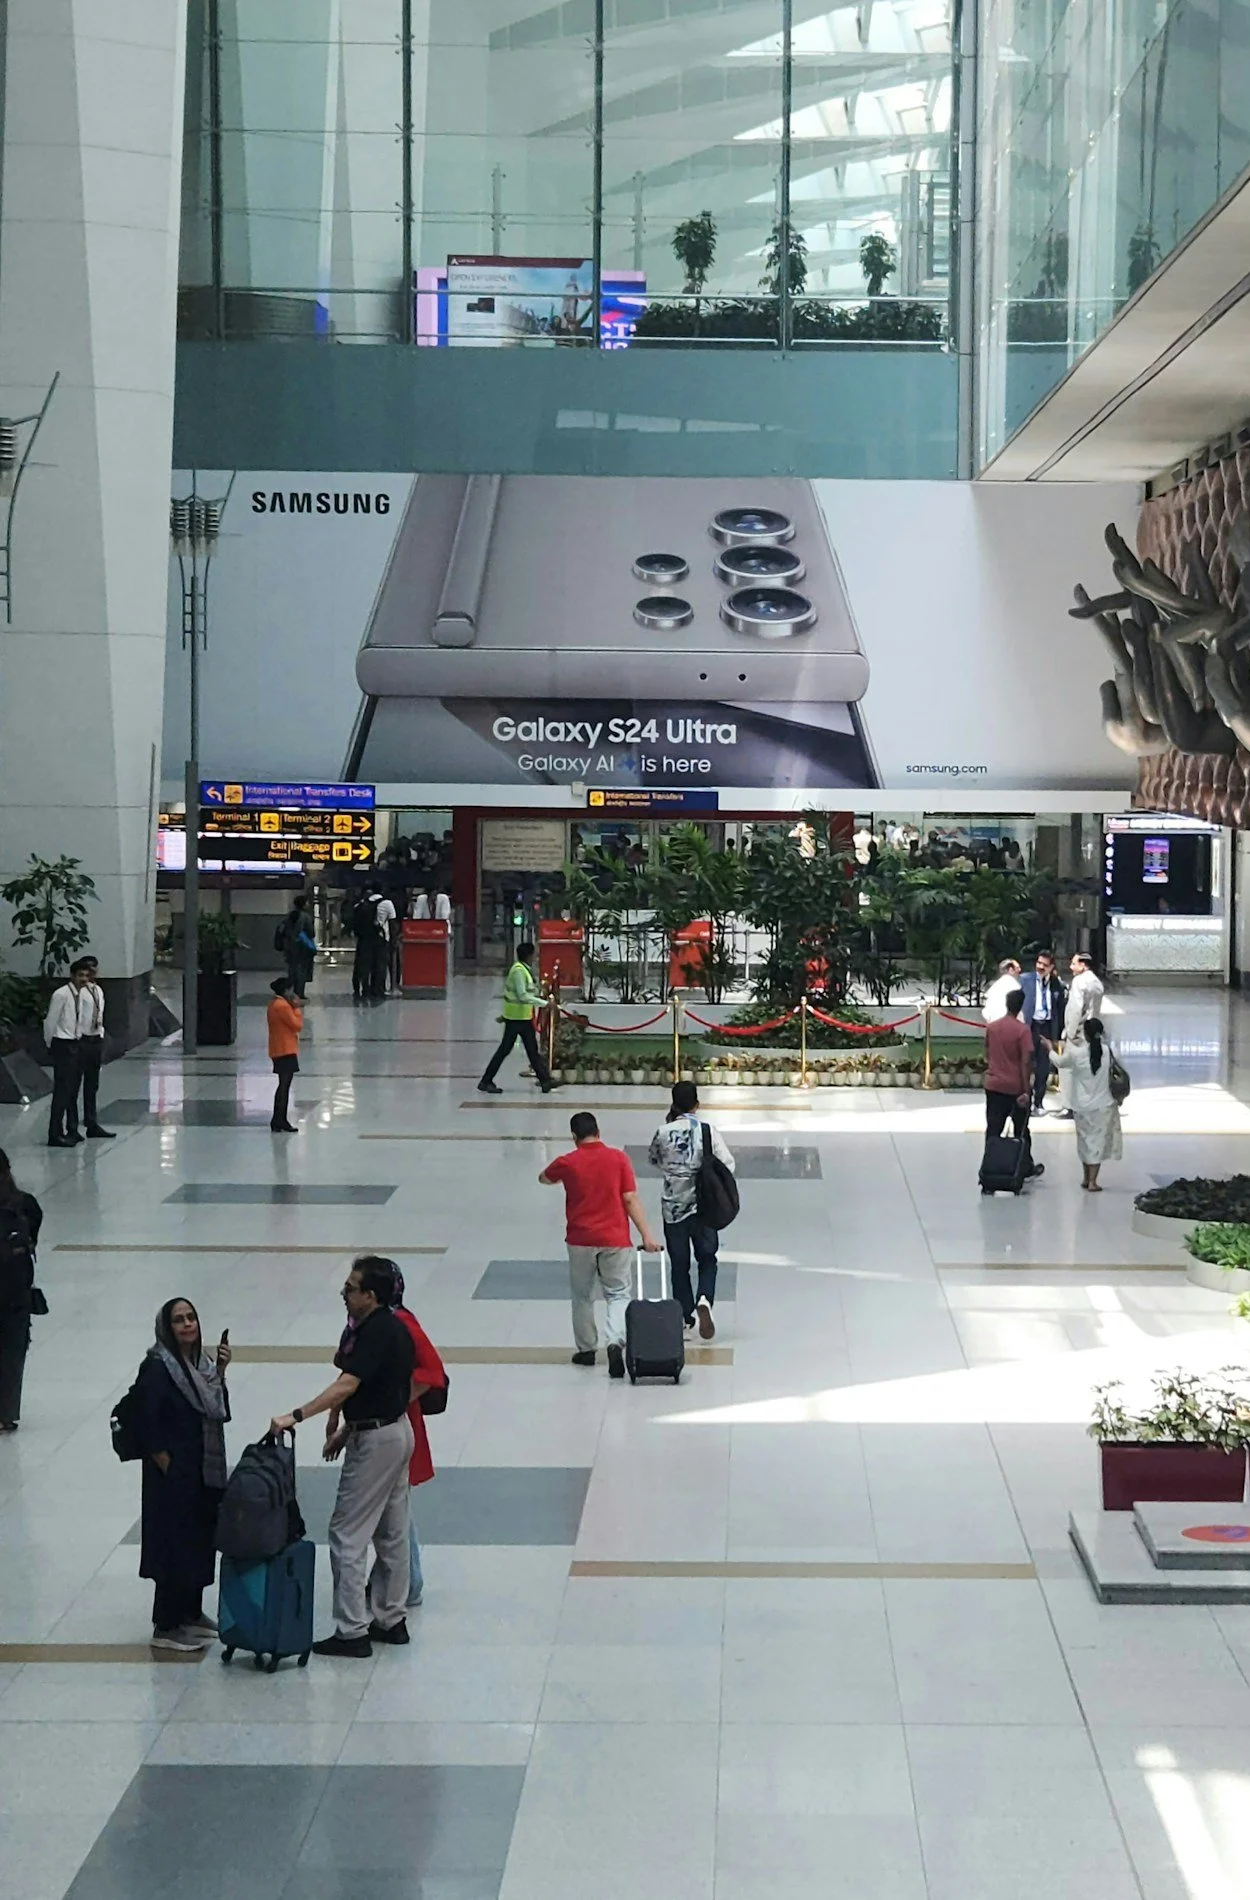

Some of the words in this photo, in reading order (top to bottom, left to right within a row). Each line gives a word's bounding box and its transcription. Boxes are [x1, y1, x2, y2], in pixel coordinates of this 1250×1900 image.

[251, 491, 390, 515] SAMSUNG
[492, 716, 602, 749] Galaxy
[608, 718, 660, 744] S24
[666, 718, 737, 745] Ultra
[518, 754, 591, 776] Galaxy
[596, 756, 614, 772] AI
[641, 755, 657, 773] is
[662, 756, 711, 773] here
[906, 765, 987, 776] samsung.com
[245, 785, 301, 797] International
[305, 787, 346, 797] Transfers
[349, 788, 373, 798] Desk
[605, 792, 650, 800] International
[212, 812, 251, 822] Terminal
[254, 813, 259, 822] 1
[283, 813, 322, 823] Terminal
[324, 814, 331, 823] 2
[270, 840, 288, 850] Exit
[291, 841, 331, 853] Baggage
